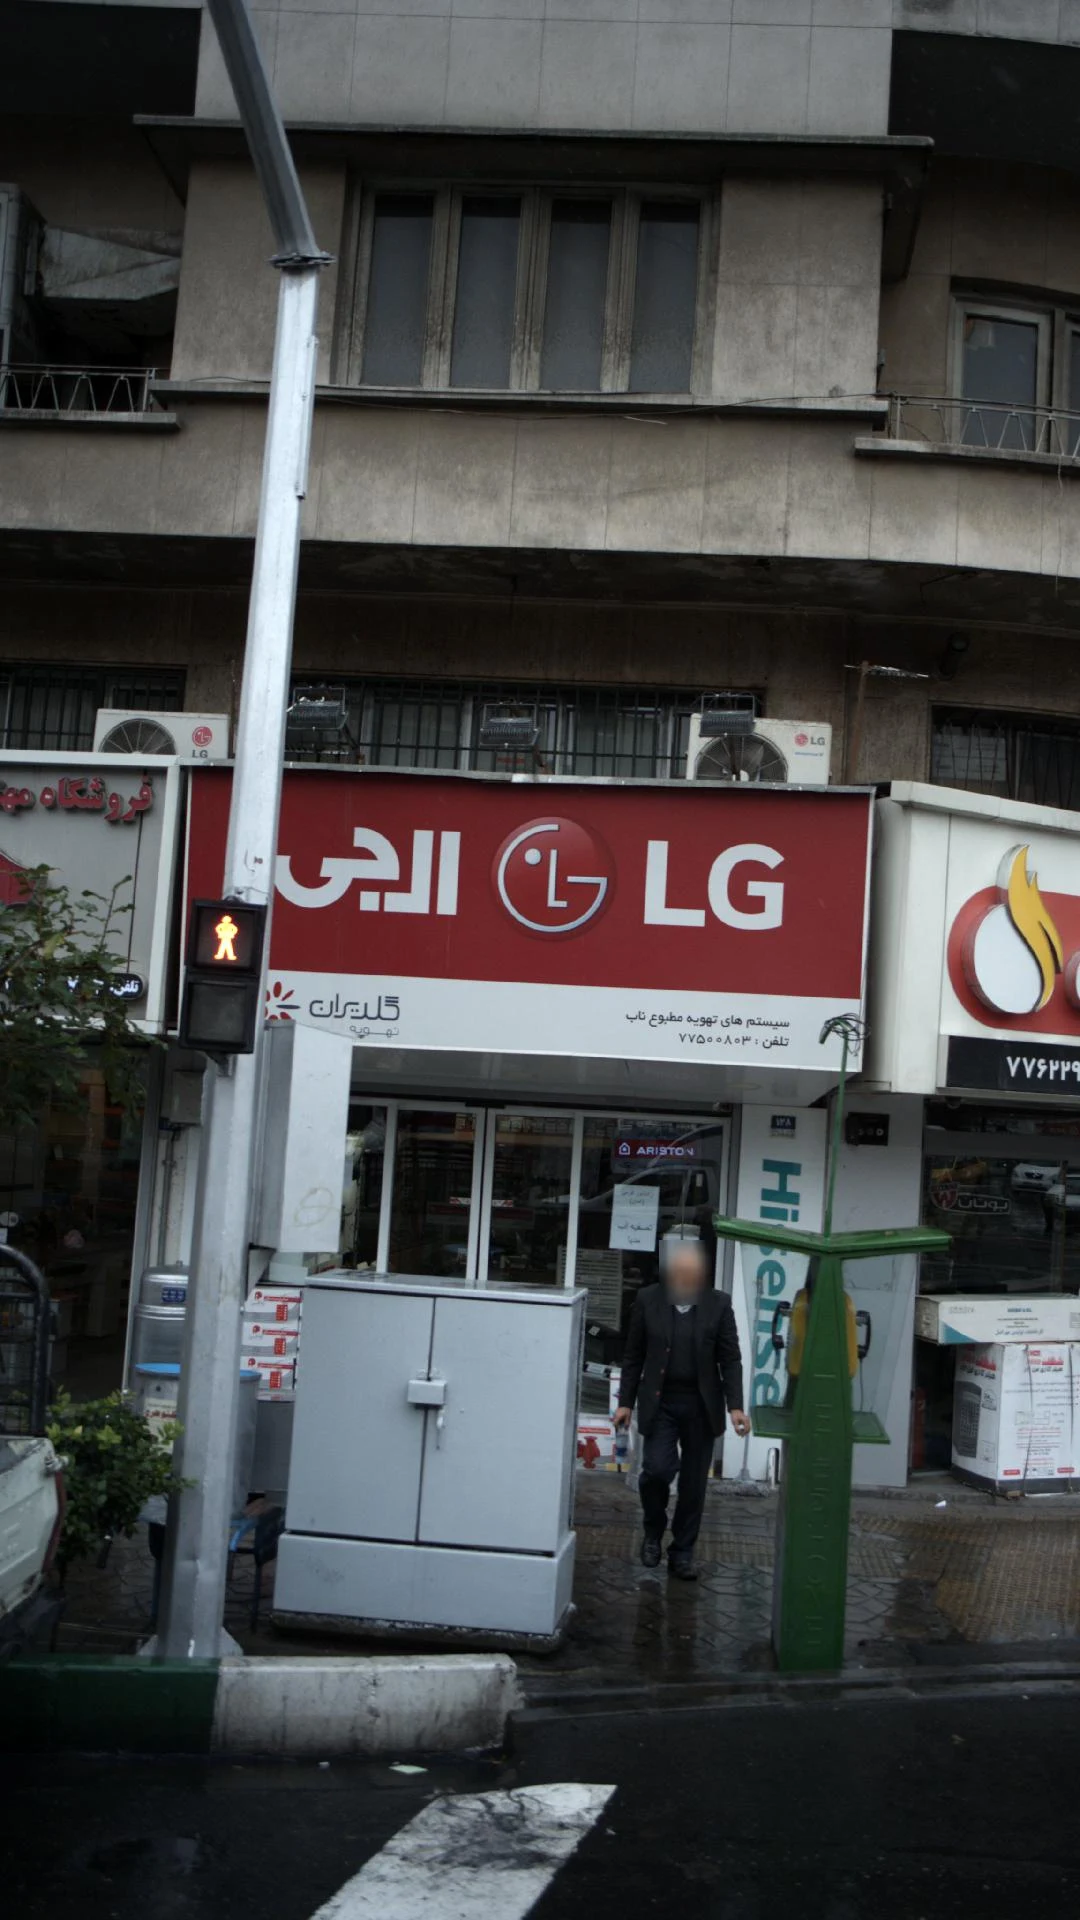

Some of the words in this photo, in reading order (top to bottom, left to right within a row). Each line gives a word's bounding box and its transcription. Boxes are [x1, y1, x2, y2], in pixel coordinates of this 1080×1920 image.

[810, 736, 826, 746] LG
[192, 749, 209, 759] LG
[0, 786, 33, 814] مه
[38, 775, 154, 821] فروشگاه
[643, 839, 785, 931] LG
[308, 992, 400, 1021] گلدیران
[625, 1010, 646, 1022] ناب
[648, 1011, 683, 1028] مطبوع
[686, 1012, 719, 1027] تهویه
[720, 1014, 743, 1028] های
[746, 1017, 790, 1030] سیستم
[679, 1032, 752, 1046] ۷۷۵۰۰۸۰۳
[636, 1146, 694, 1156] ARISTON
